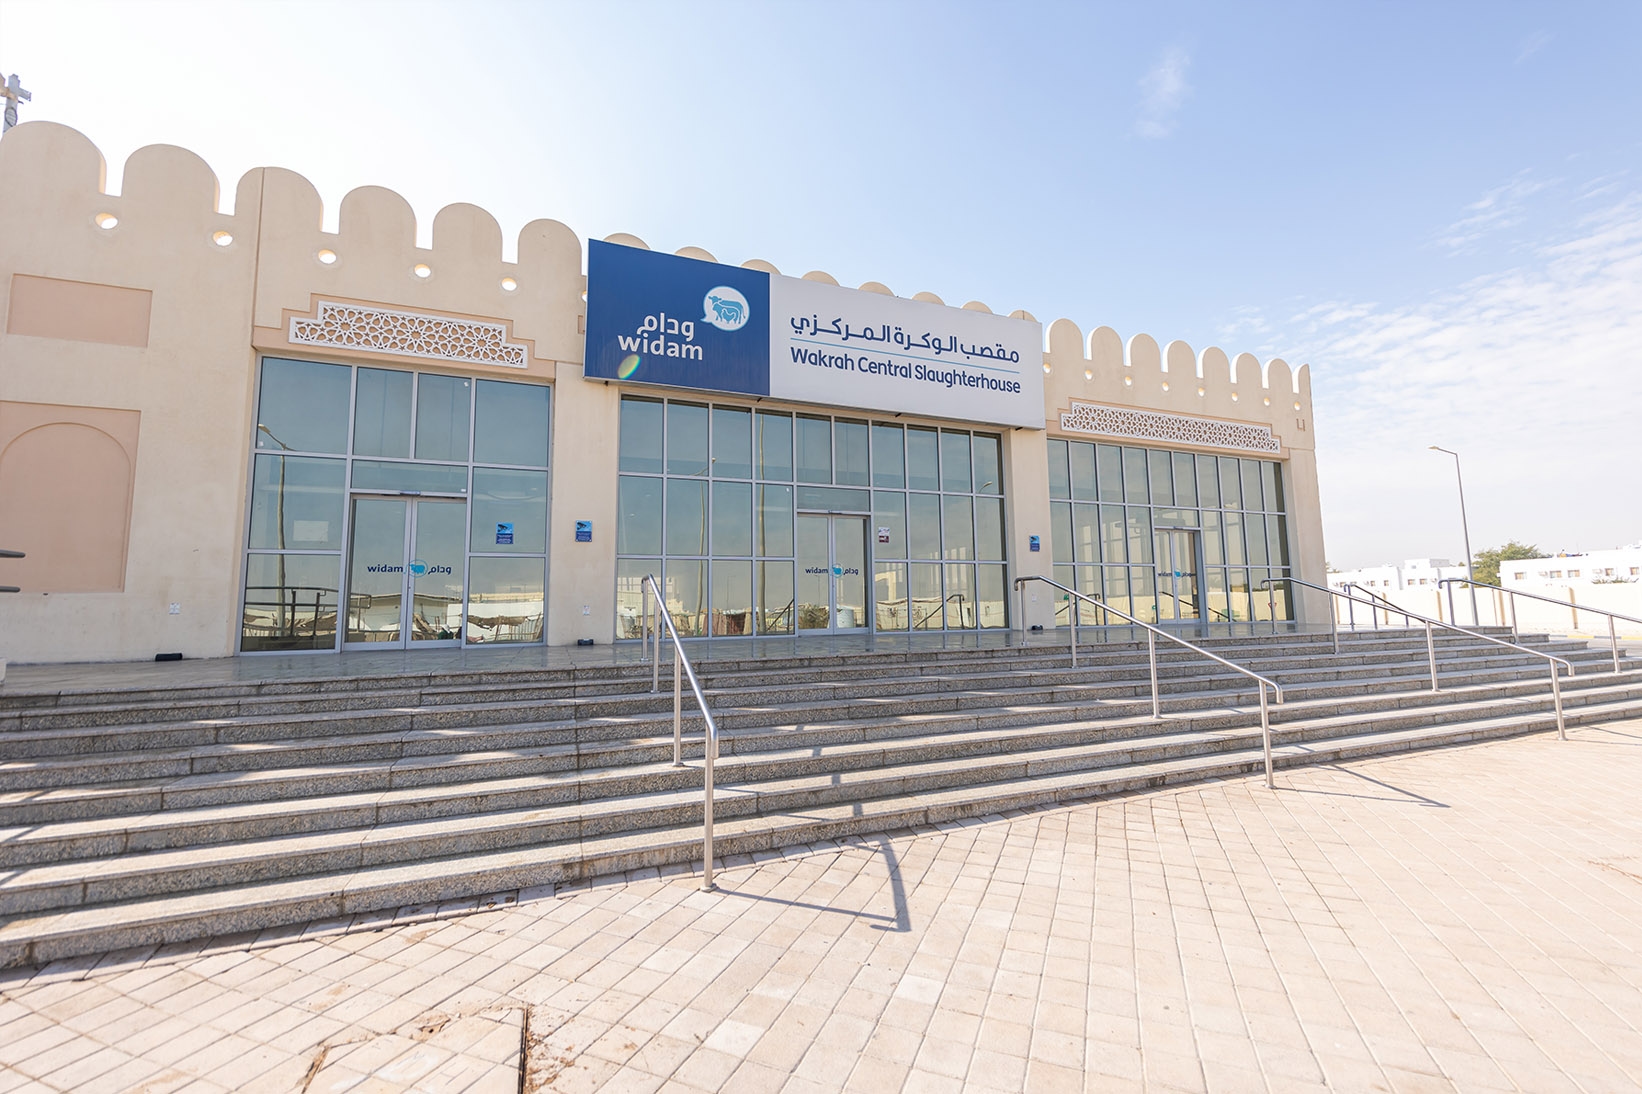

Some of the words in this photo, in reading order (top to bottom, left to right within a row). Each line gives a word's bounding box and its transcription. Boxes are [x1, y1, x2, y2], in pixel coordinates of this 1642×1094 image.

[637, 312, 695, 342] ودام
[790, 314, 890, 343] المركزي
[893, 326, 957, 355] الوكرة
[617, 332, 704, 361] widam
[960, 343, 1020, 364] مقصب
[790, 346, 855, 371] Wakrah
[858, 356, 912, 379] Central
[914, 364, 1021, 394] Slaughterhouse
[367, 564, 404, 573] widam
[427, 565, 452, 575] ودام
